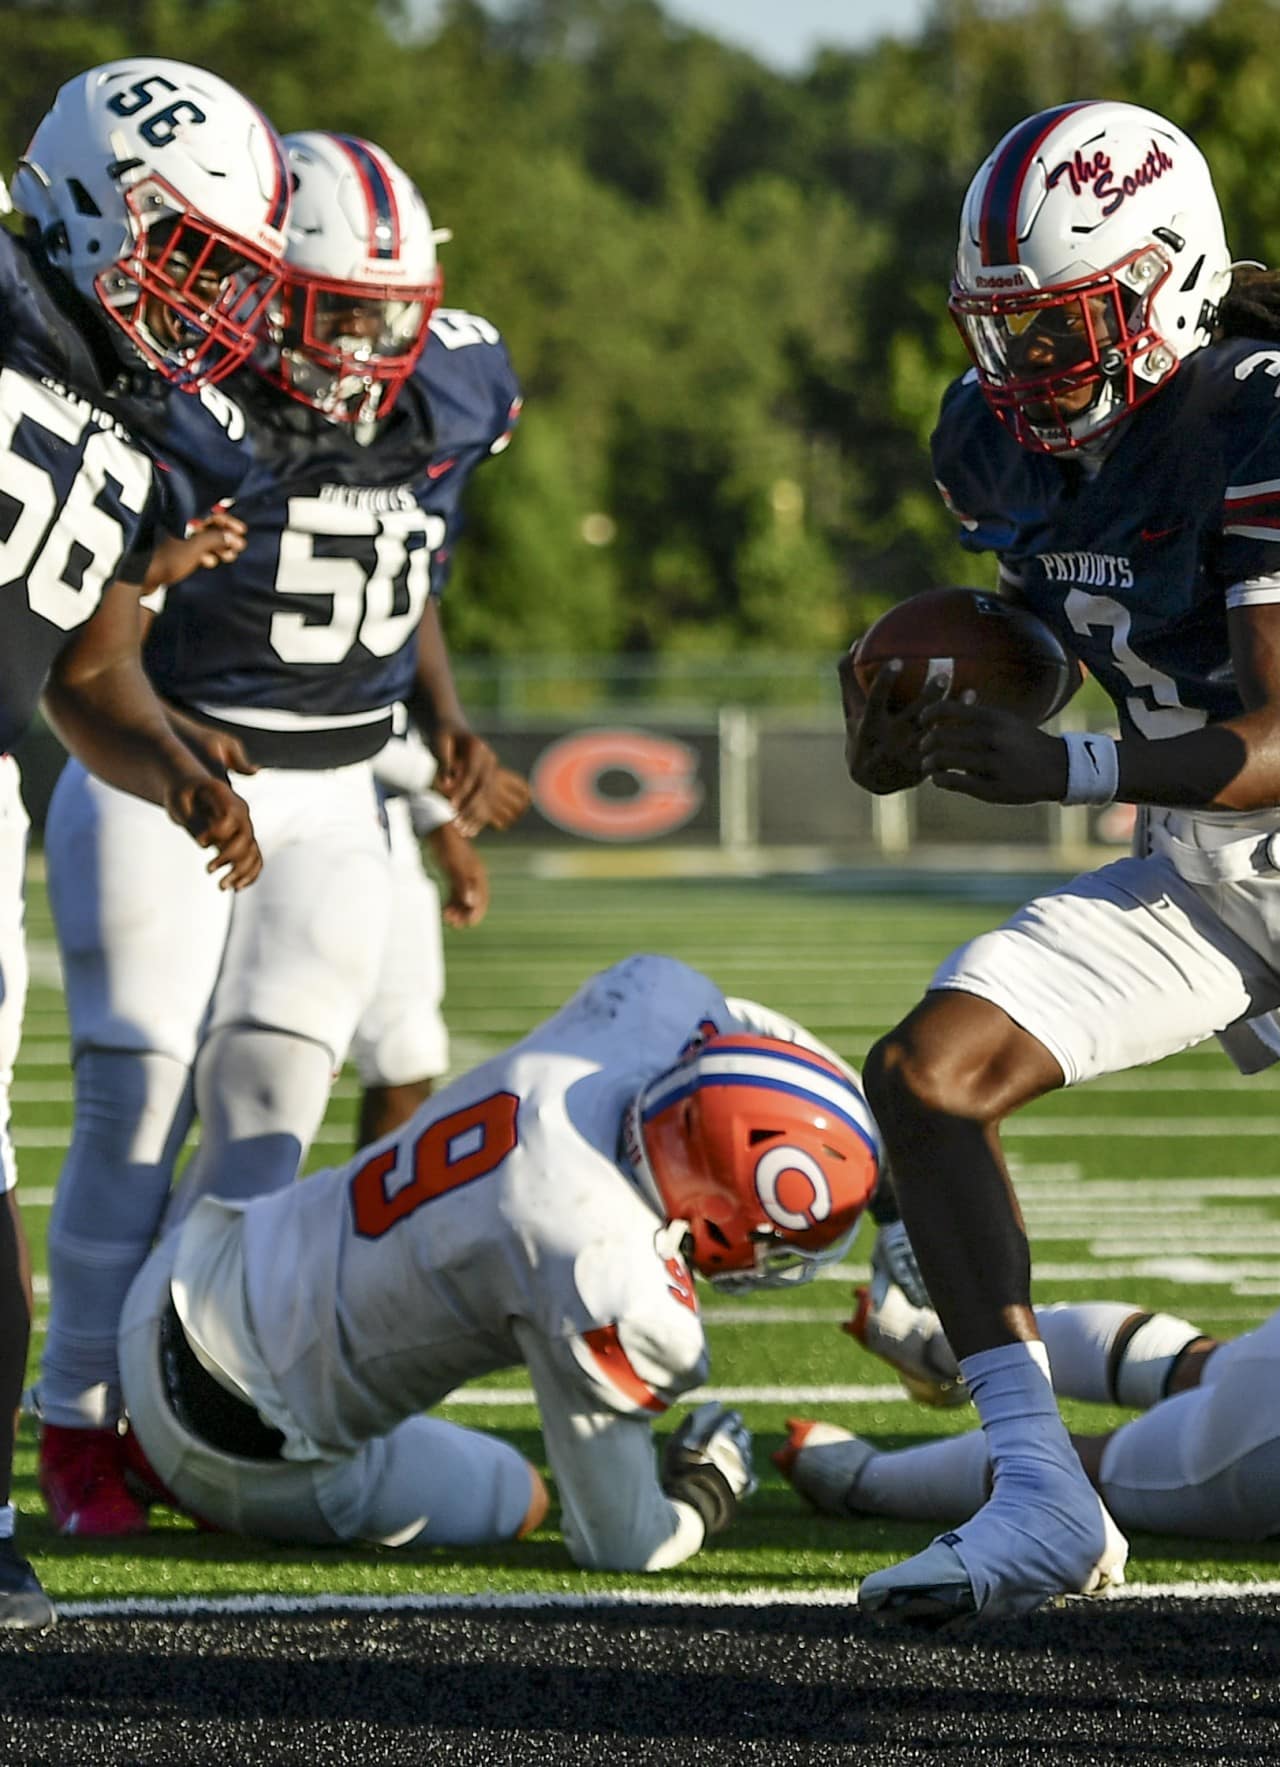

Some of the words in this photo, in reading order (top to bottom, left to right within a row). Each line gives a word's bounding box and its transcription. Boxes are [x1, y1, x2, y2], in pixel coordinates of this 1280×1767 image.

[106, 75, 207, 148] 56
[1046, 149, 1112, 196] The
[1093, 138, 1174, 218] South
[0, 366, 154, 632] 56
[268, 495, 446, 665] 50
[1037, 551, 1134, 589] PATRIOTS
[1063, 587, 1208, 741] 3
[532, 725, 702, 843] C
[349, 1090, 520, 1241] 9
[755, 1144, 833, 1232] C
